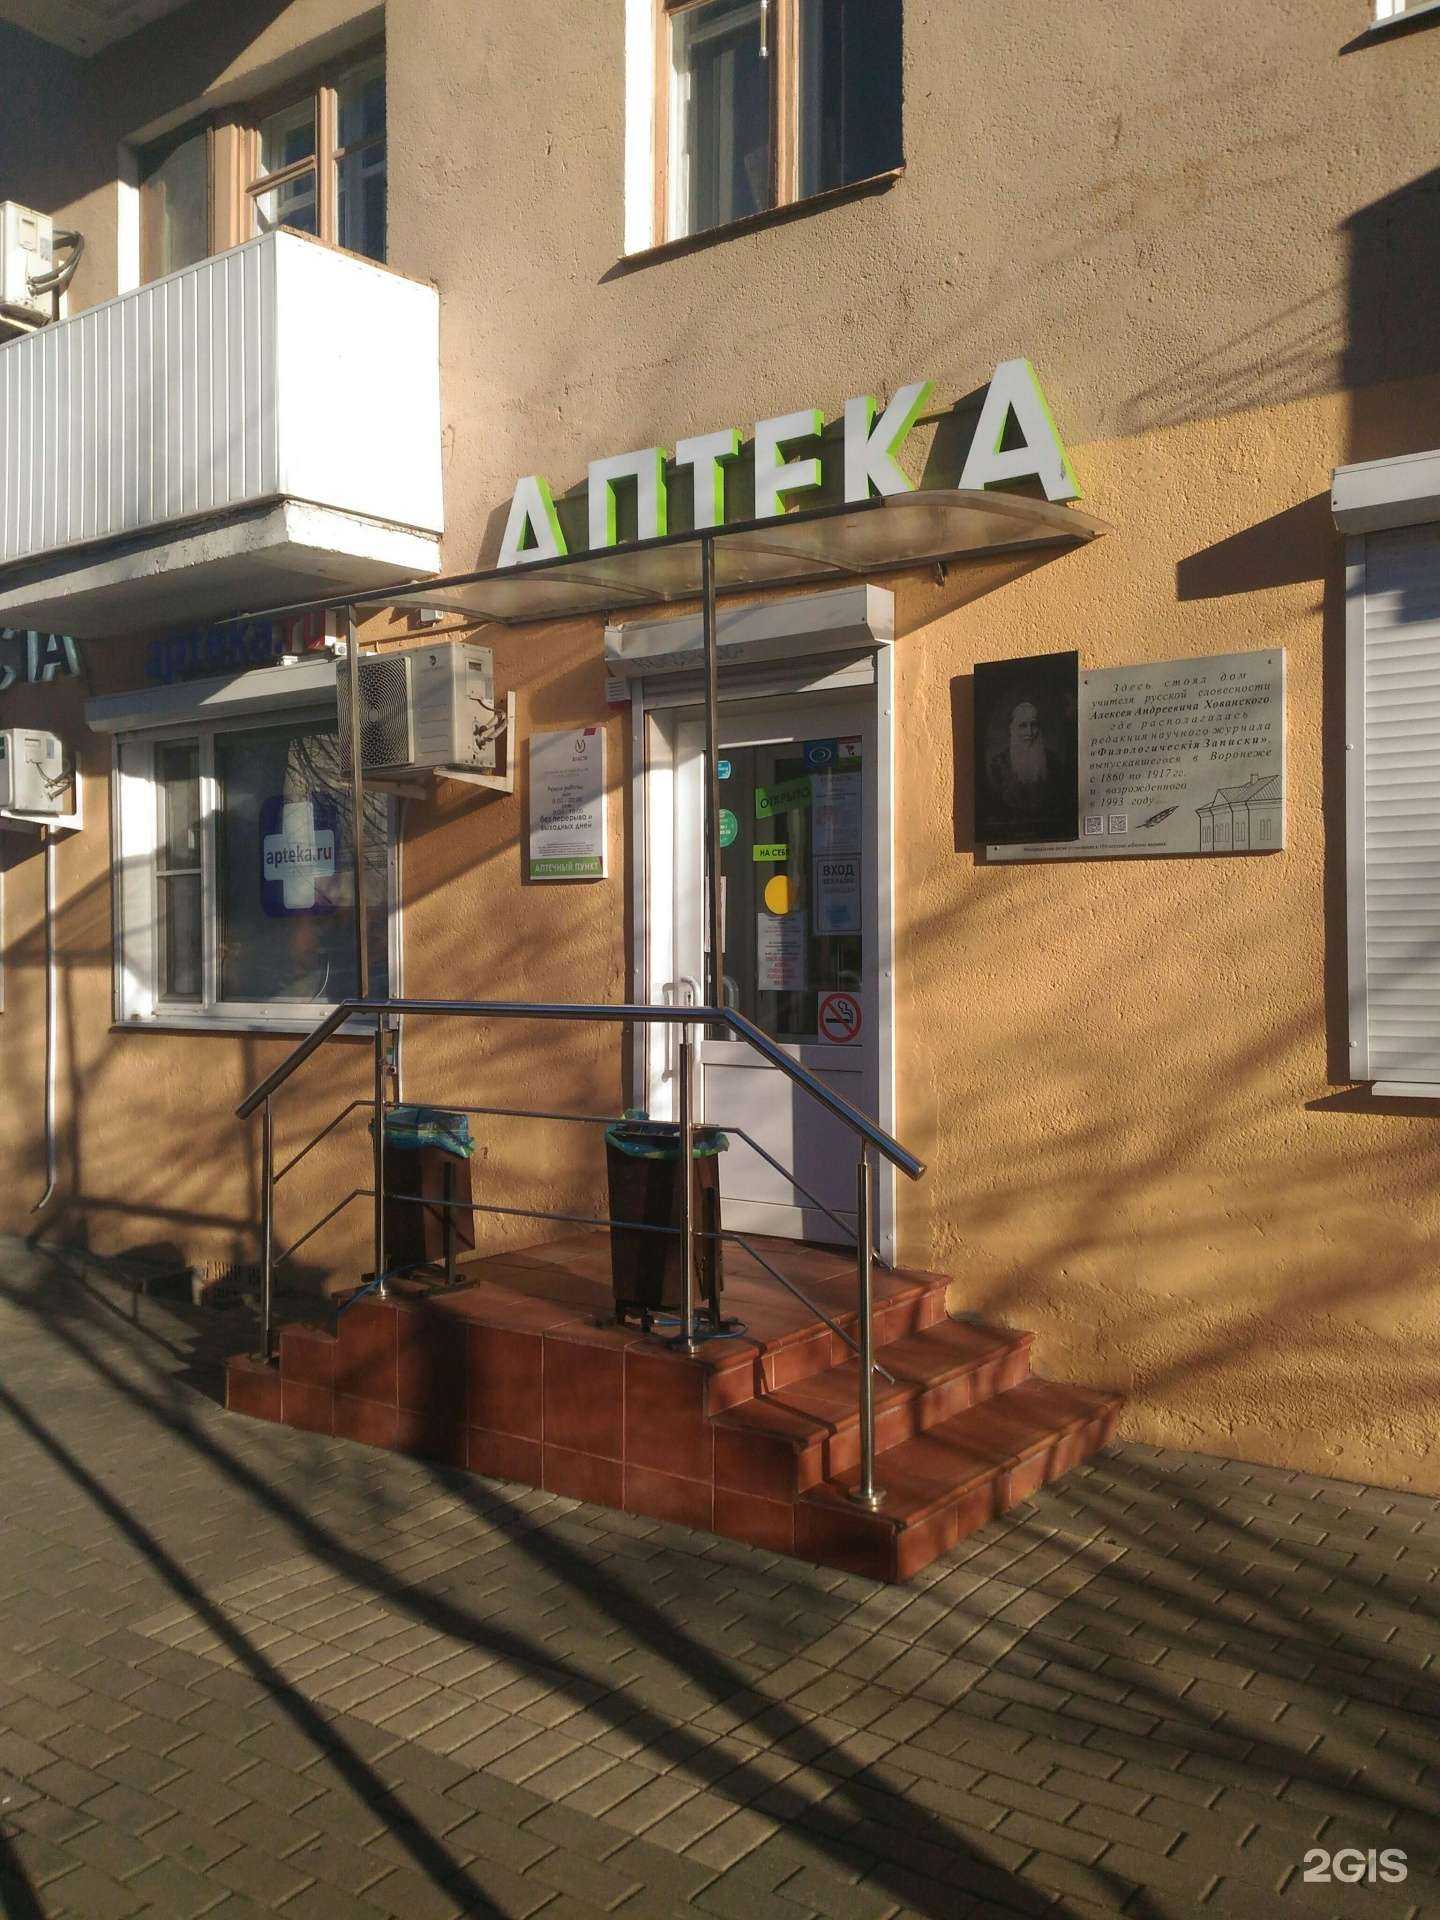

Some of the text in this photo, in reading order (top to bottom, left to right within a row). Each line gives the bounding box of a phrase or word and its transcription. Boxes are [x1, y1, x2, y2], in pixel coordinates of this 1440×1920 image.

[497, 356, 1083, 568] АПТЕКА
[1113, 672, 1247, 693] Здесь стоял дом
[1092, 682, 1271, 708] учителя русской словесности
[1090, 709, 1132, 721] Алексея
[1135, 703, 1199, 718] Андреевича
[1110, 712, 1249, 731] где располагалась
[1090, 722, 1271, 747] редакция научного журнала
[1089, 756, 1181, 770] выпускавшегося
[1210, 749, 1272, 762] Воронеже
[1101, 772, 1125, 784] 1860
[1129, 772, 1142, 781] по
[1147, 768, 1172, 780] 1917
[760, 786, 811, 809] ОТКРЫТО
[1105, 783, 1187, 797] возрожденного
[1101, 797, 1124, 808] 1993
[1131, 796, 1154, 808] году
[266, 844, 332, 869] apteka.ru
[760, 848, 790, 857] НА СЕБЯ
[535, 861, 599, 873] АПТЕЧНЫЙ ПУНКТ
[823, 863, 855, 877] ВХОД
